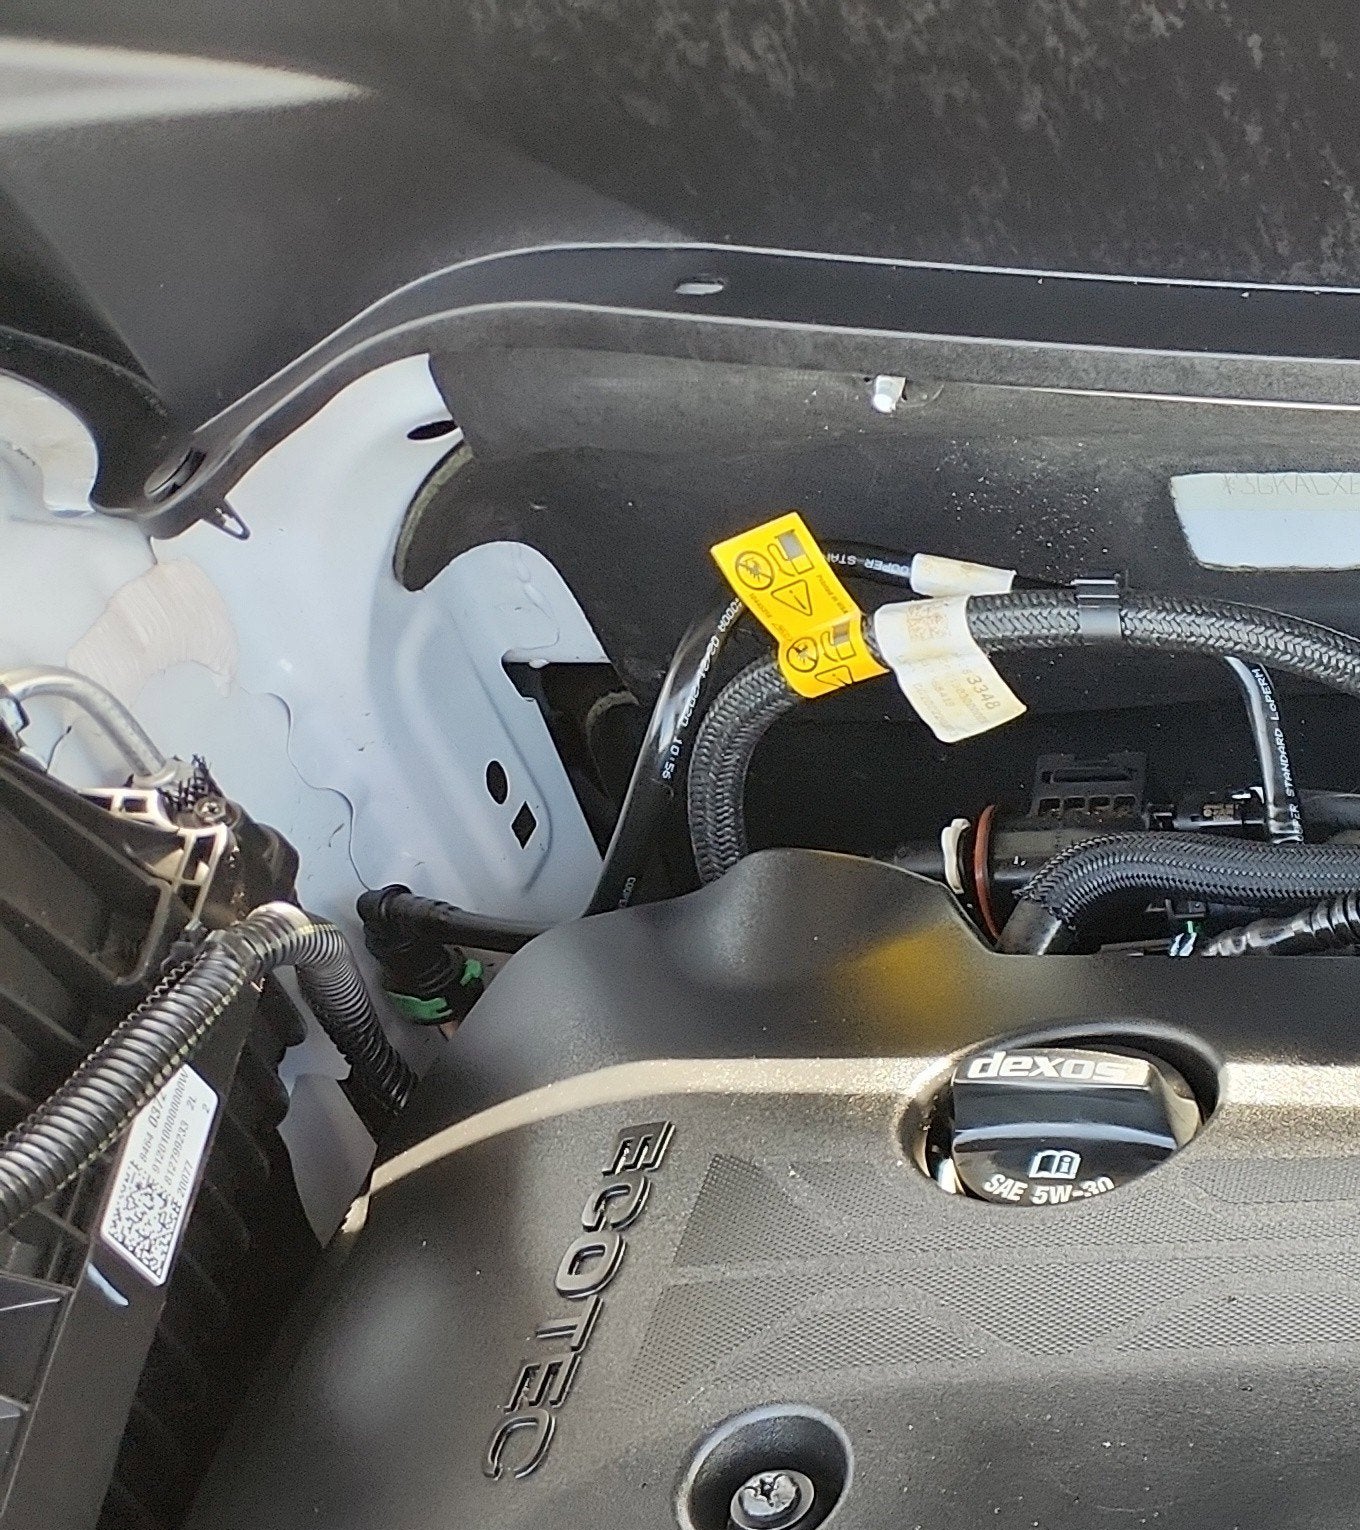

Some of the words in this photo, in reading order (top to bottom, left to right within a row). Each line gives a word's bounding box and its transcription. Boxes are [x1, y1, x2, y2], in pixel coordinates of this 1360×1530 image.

[1274, 727, 1297, 798] STANDARD
[983, 1173, 1028, 1201] SAE
[482, 1119, 676, 1480] ECOTEC
